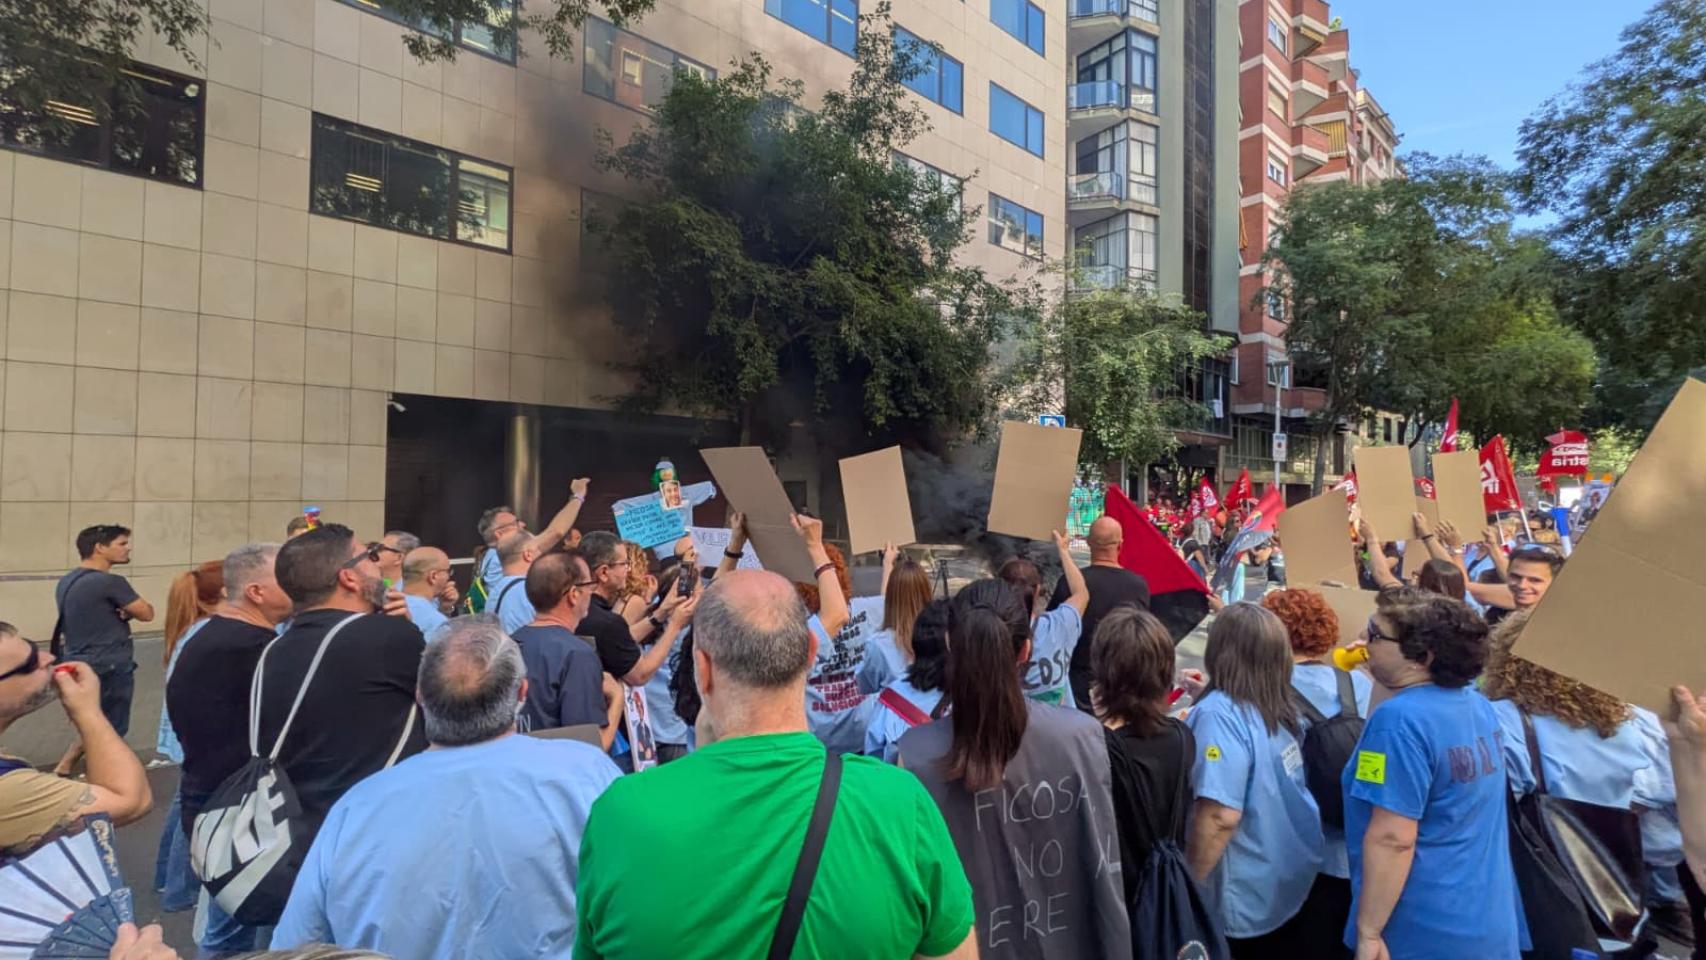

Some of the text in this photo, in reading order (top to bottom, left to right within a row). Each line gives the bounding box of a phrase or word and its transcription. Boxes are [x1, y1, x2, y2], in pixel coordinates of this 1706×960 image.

[975, 776, 1092, 833] FICOSA
[1015, 839, 1064, 888] NO
[989, 892, 1070, 948] ERE
